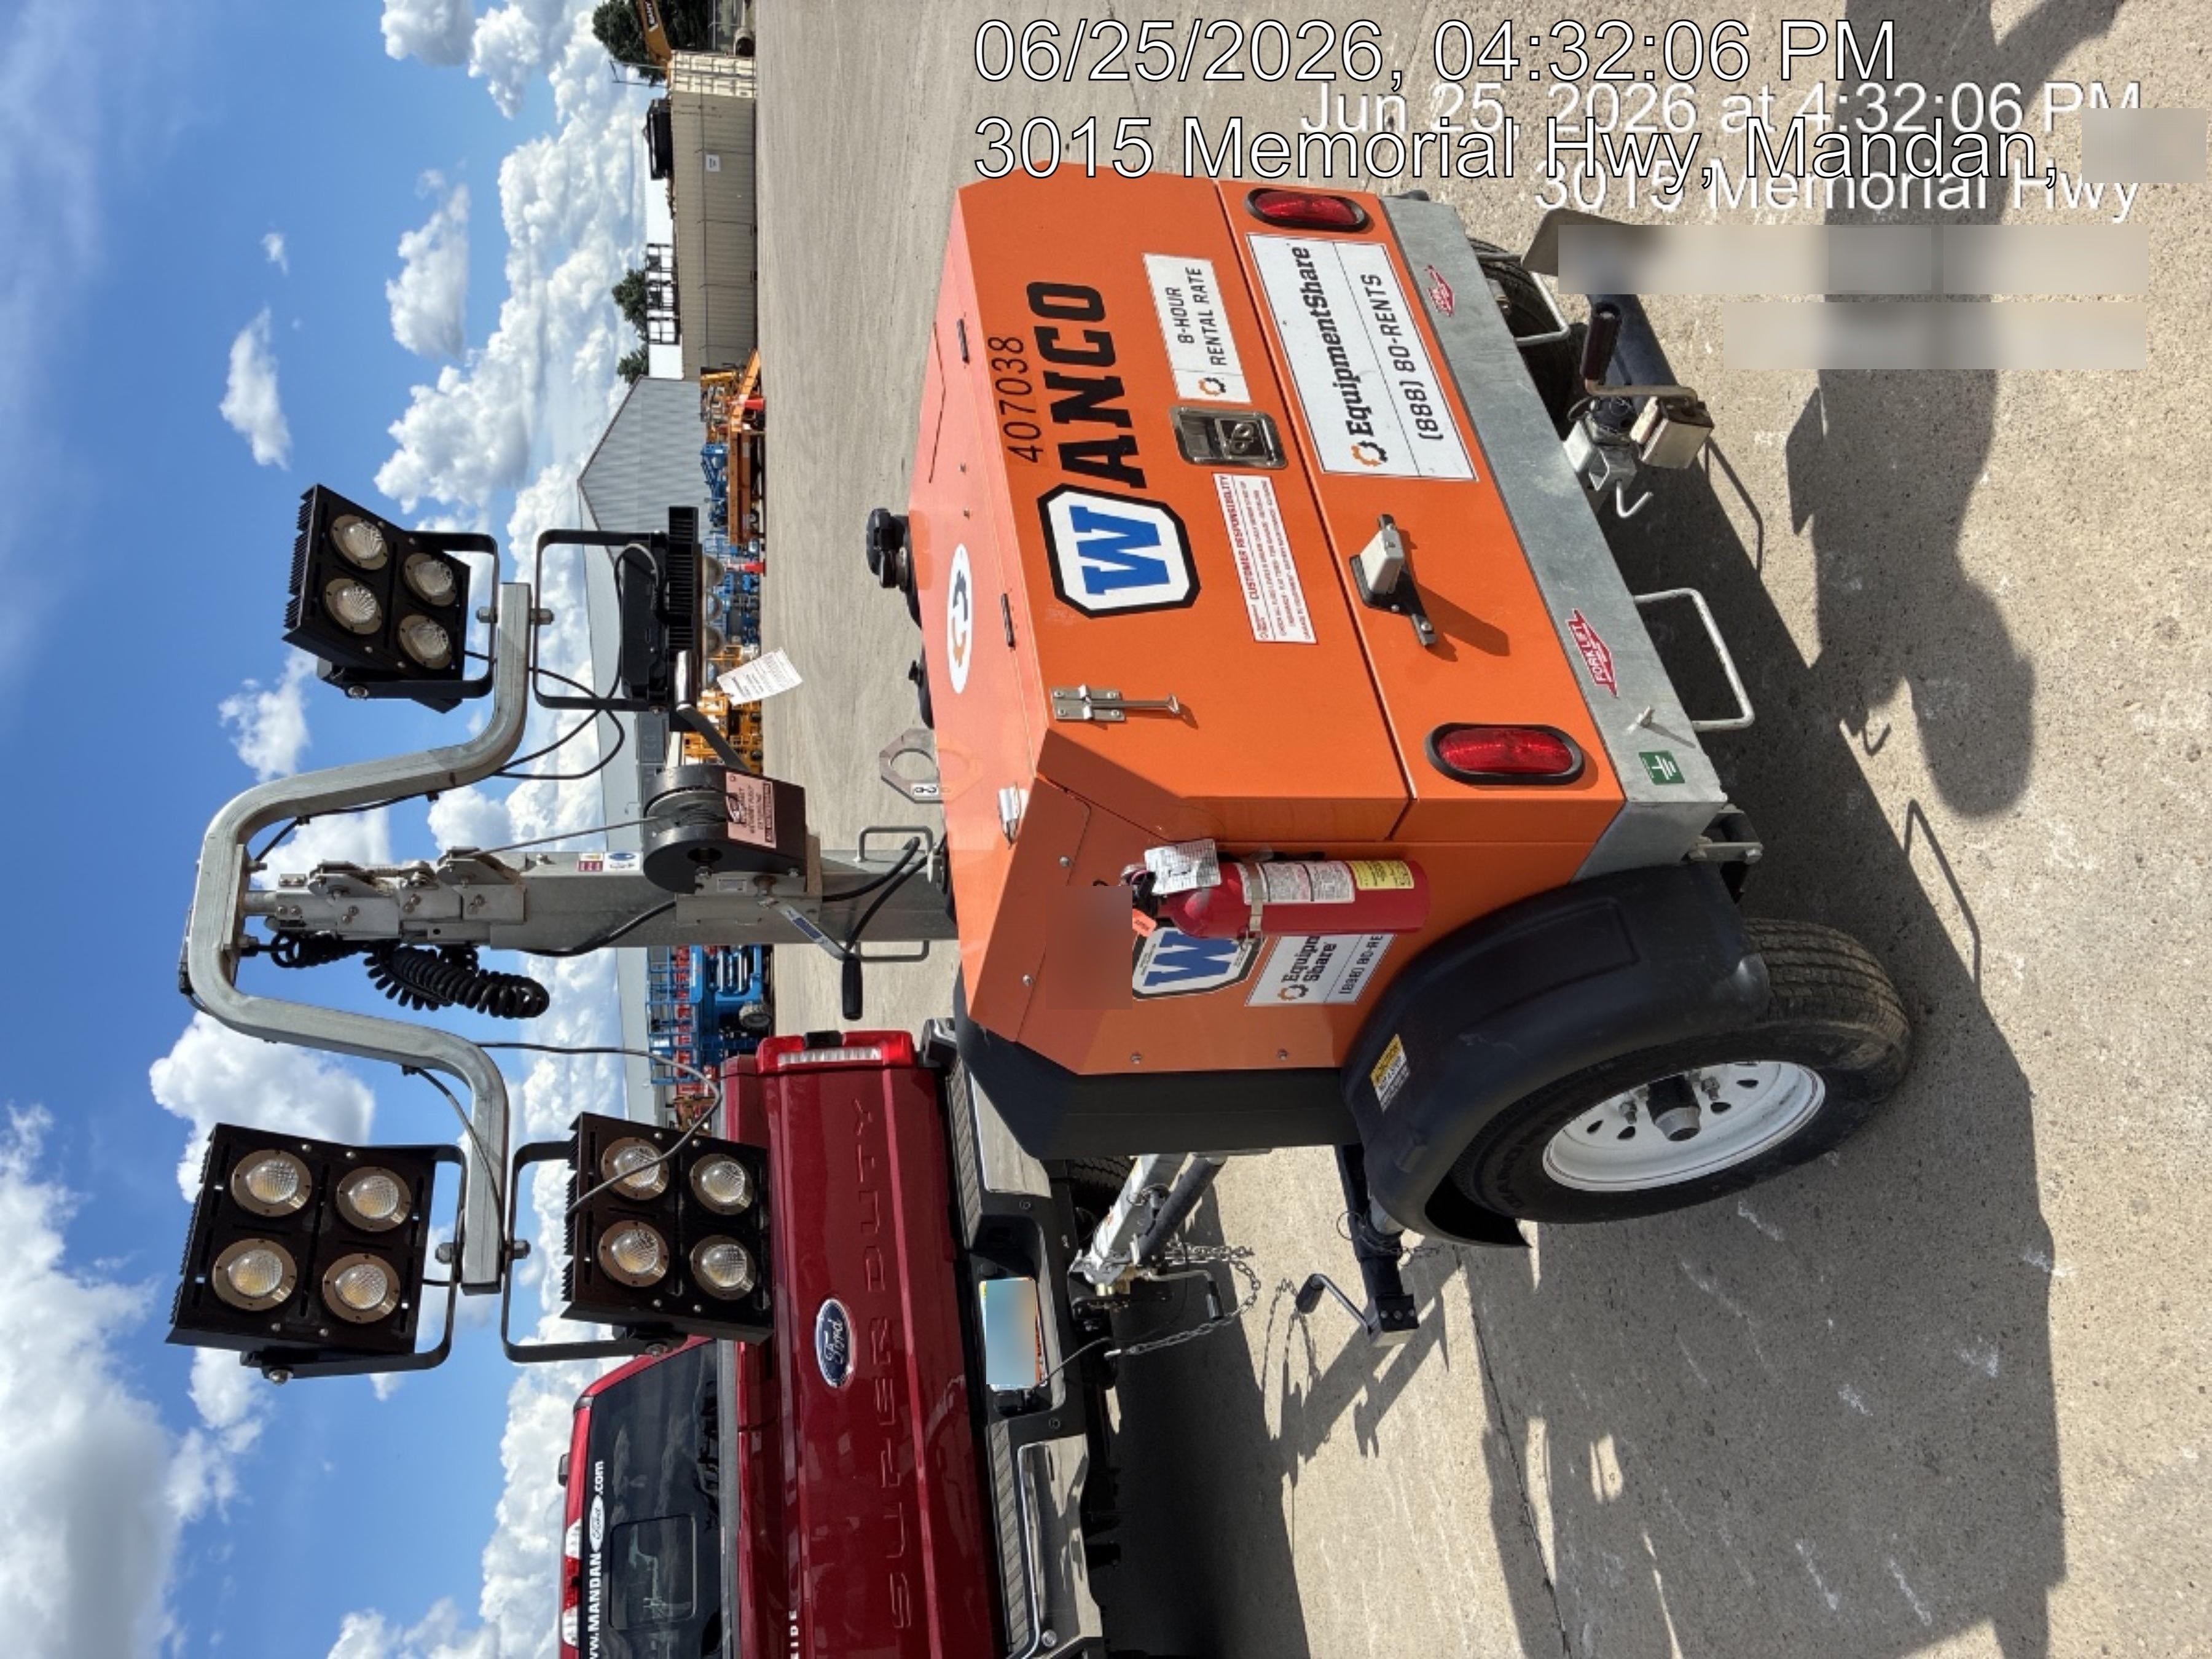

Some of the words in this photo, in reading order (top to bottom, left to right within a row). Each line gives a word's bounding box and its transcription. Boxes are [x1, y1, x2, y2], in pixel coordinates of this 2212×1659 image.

[1185, 266, 1210, 304] RATE
[1166, 286, 1196, 344] 8-HOUR
[1199, 310, 1229, 366] RENTAL
[1291, 246, 1376, 437] EquipmentShare
[1360, 273, 1416, 373] 80-RENTS
[987, 336, 1044, 463] 407038
[1399, 380, 1444, 441] (888)
[1218, 475, 1246, 548] RESPONSIBILITY
[1238, 551, 1260, 600] CUSTOMER
[1572, 624, 1591, 647] LIFT
[1583, 650, 1606, 681] FORK
[1281, 935, 1320, 982] Equipm
[1302, 943, 1337, 982] Share
[1356, 935, 1384, 965] 80-RE
[853, 1098, 885, 1292] DUTY
[823, 1317, 845, 1364] Ford
[869, 1317, 912, 1629] SUPER
